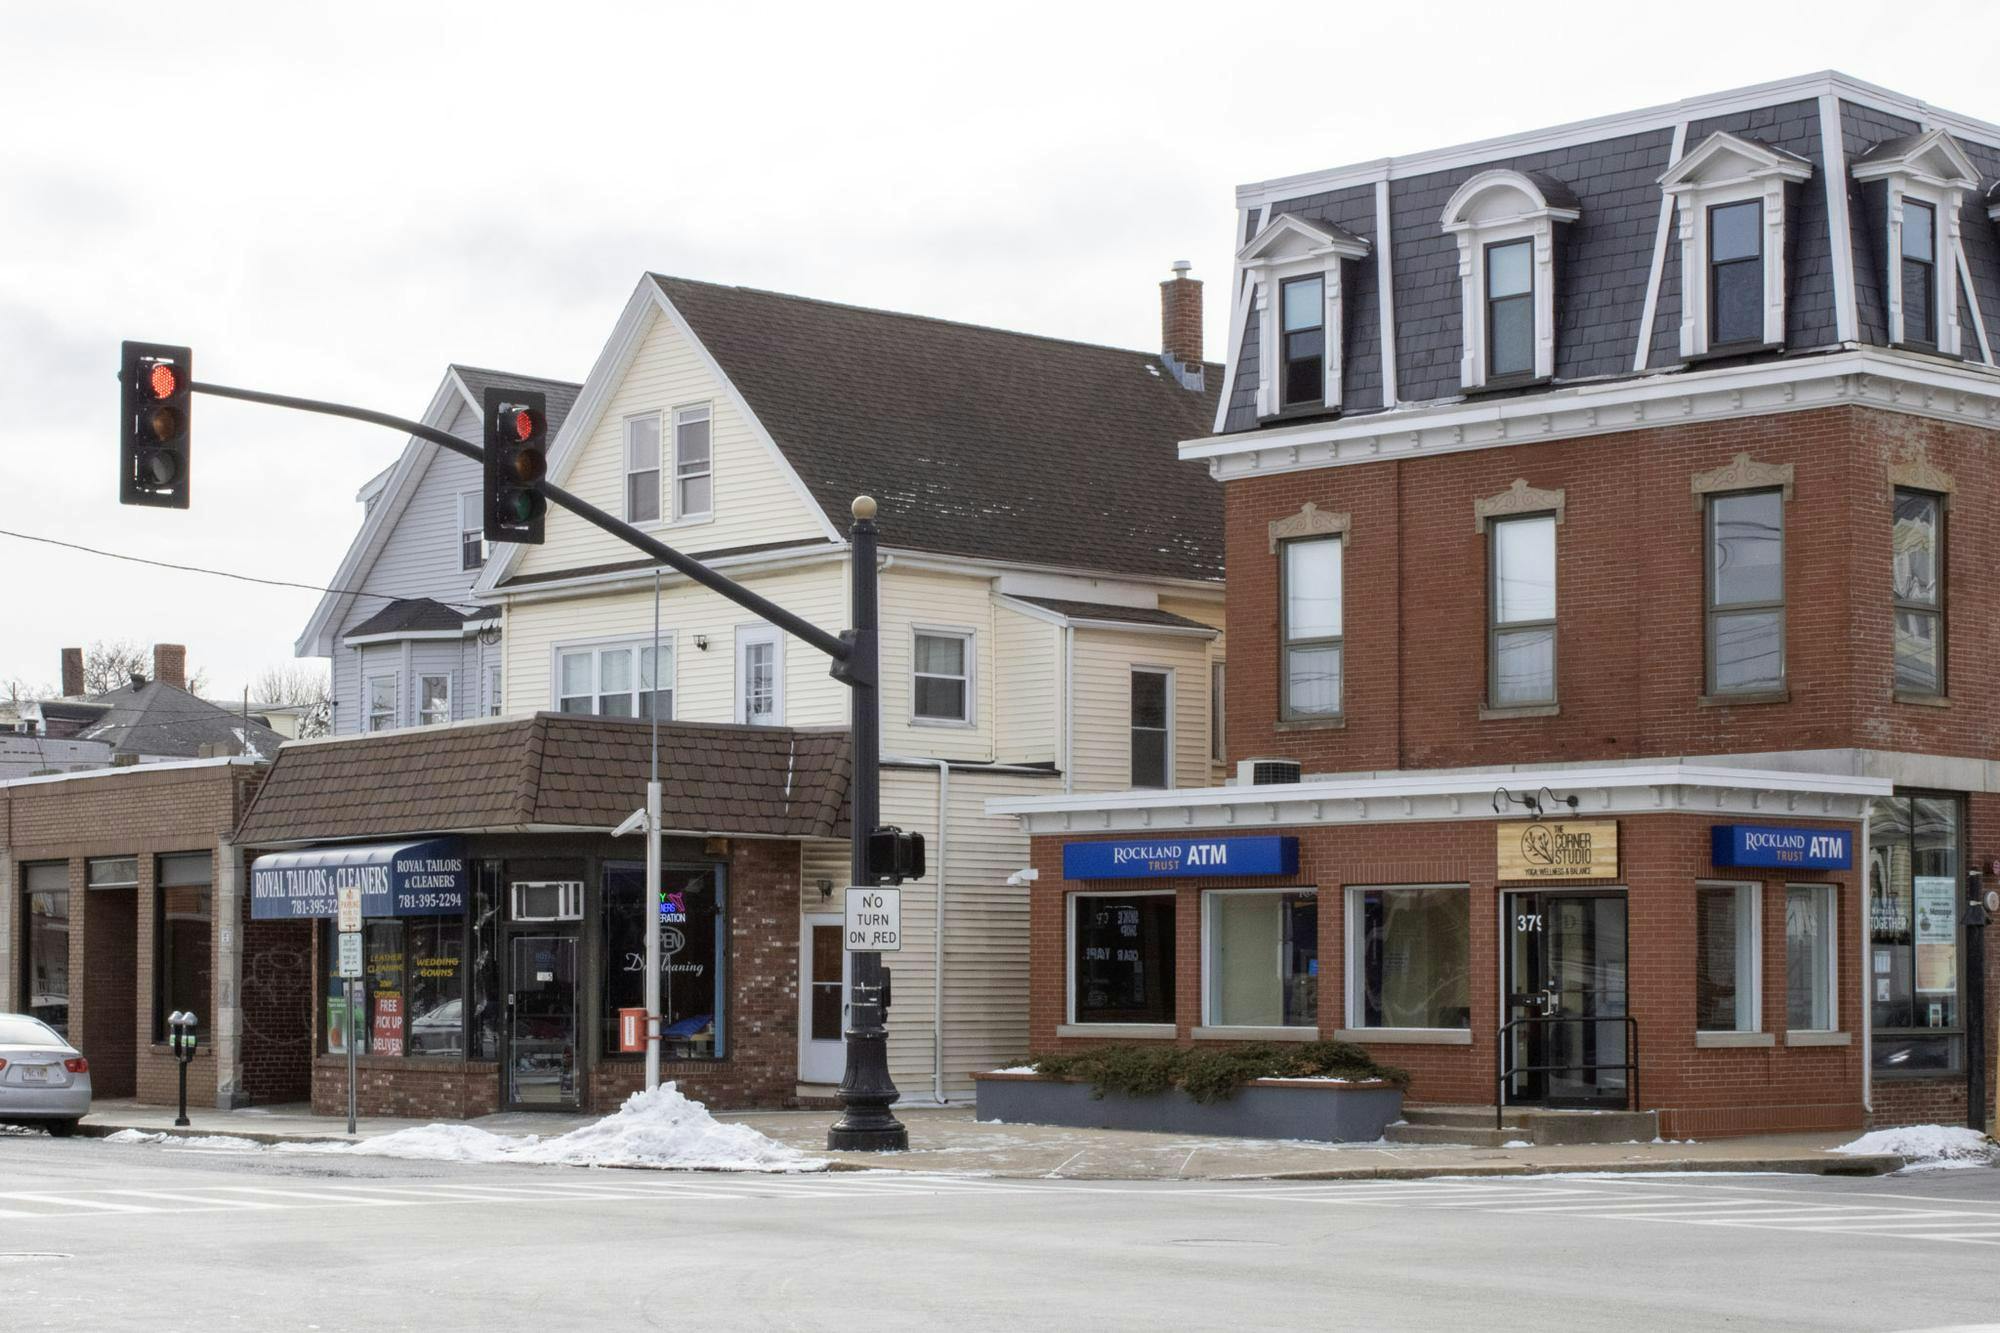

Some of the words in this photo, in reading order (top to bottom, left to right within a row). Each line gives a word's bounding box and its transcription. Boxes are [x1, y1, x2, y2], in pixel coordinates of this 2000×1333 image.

[1554, 825, 1564, 833] THE
[1555, 833, 1592, 848] CORNER
[1745, 832, 1805, 850] ROCKLAND
[1809, 836, 1843, 858] ATM
[1113, 846, 1182, 863] ROCKLAND
[1187, 844, 1227, 865] ATM
[1555, 848, 1592, 865] STUDIO
[1777, 850, 1803, 861] TRUST
[397, 860, 425, 873] ROYAL
[426, 859, 462, 872] TAILORS
[1148, 861, 1180, 871] TRUST
[1570, 867, 1592, 875] BALANCE
[255, 871, 286, 898] ROYAL
[286, 869, 327, 897] TAILORS
[328, 875, 335, 896] &
[336, 866, 389, 895] CLEANERS
[404, 878, 411, 889] &
[411, 875, 455, 888] CLEANERS
[291, 899, 339, 915] 781-395-22
[399, 893, 462, 908] 781-395-2294
[862, 896, 883, 908] NO
[660, 913, 686, 922] ERATION
[857, 914, 889, 926] TURN
[1870, 916, 1908, 930] TOGETHER
[850, 931, 866, 943] ON
[873, 931, 897, 943] RED
[416, 957, 459, 967] WEDDING
[661, 960, 704, 977] leaning
[420, 968, 454, 977] GOWNS
[380, 999, 398, 1012] FREE
[375, 1016, 391, 1028] PICK
[391, 1016, 403, 1028] UP
